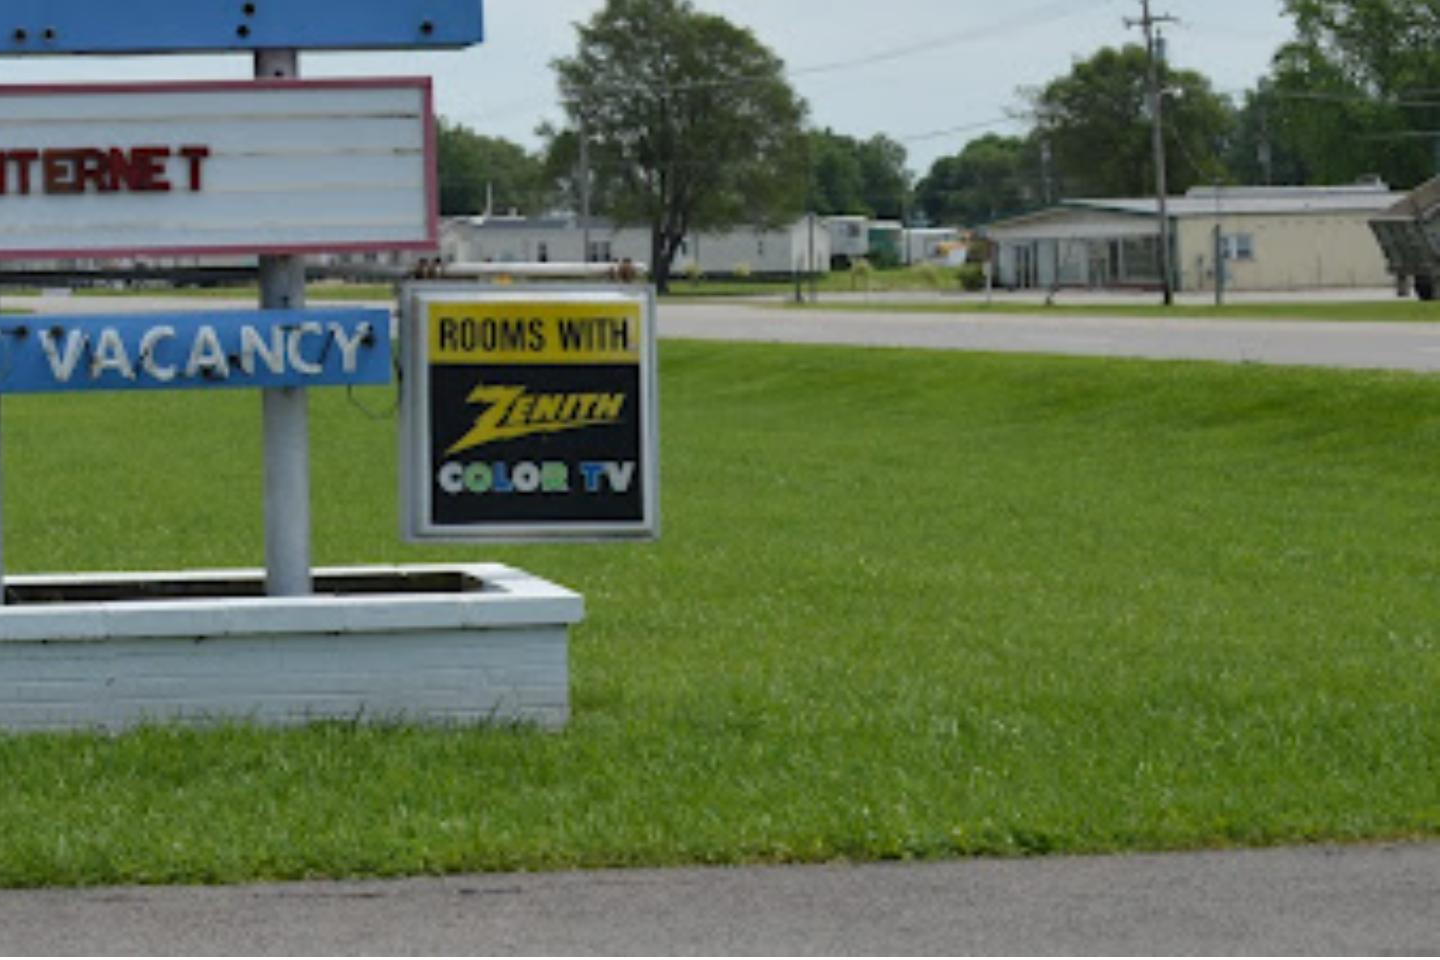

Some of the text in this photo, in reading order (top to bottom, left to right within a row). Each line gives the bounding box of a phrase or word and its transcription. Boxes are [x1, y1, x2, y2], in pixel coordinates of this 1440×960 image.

[38, 320, 373, 382] VACANCY
[438, 316, 629, 352] ROOMS WITH
[443, 384, 626, 456] ZENITH
[438, 460, 636, 493] COLOR TV
